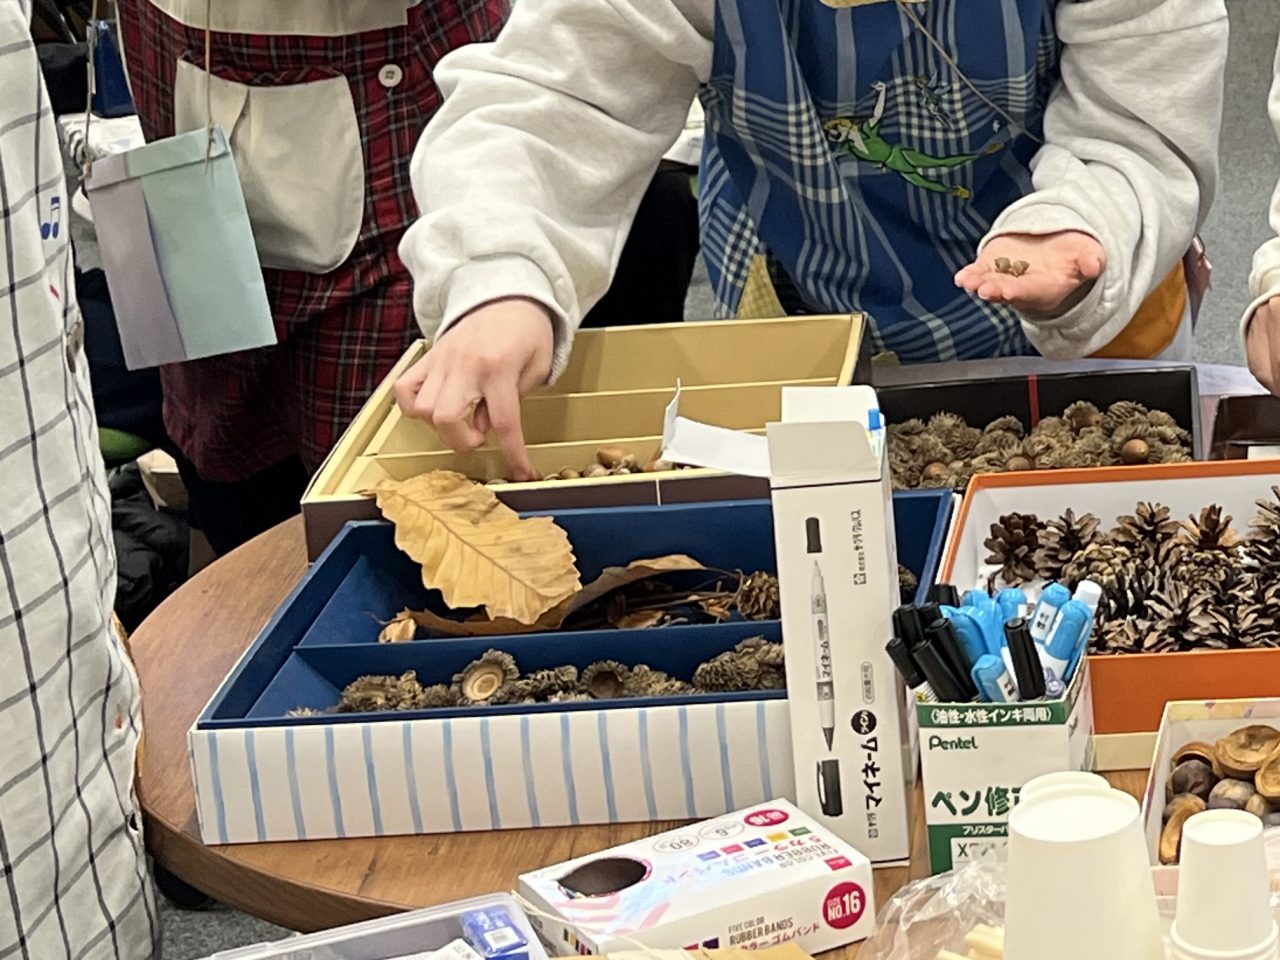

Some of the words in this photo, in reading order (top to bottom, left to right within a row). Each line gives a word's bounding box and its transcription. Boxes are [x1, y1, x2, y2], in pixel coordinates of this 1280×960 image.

[929, 735, 978, 751] Pentel
[861, 737, 882, 810] マイネーム
[775, 843, 832, 862] RUBBER
[728, 921, 744, 933] FIVE
[744, 916, 765, 929] COLOR
[730, 926, 764, 946] RUBBER
[765, 917, 794, 934] BANDS
